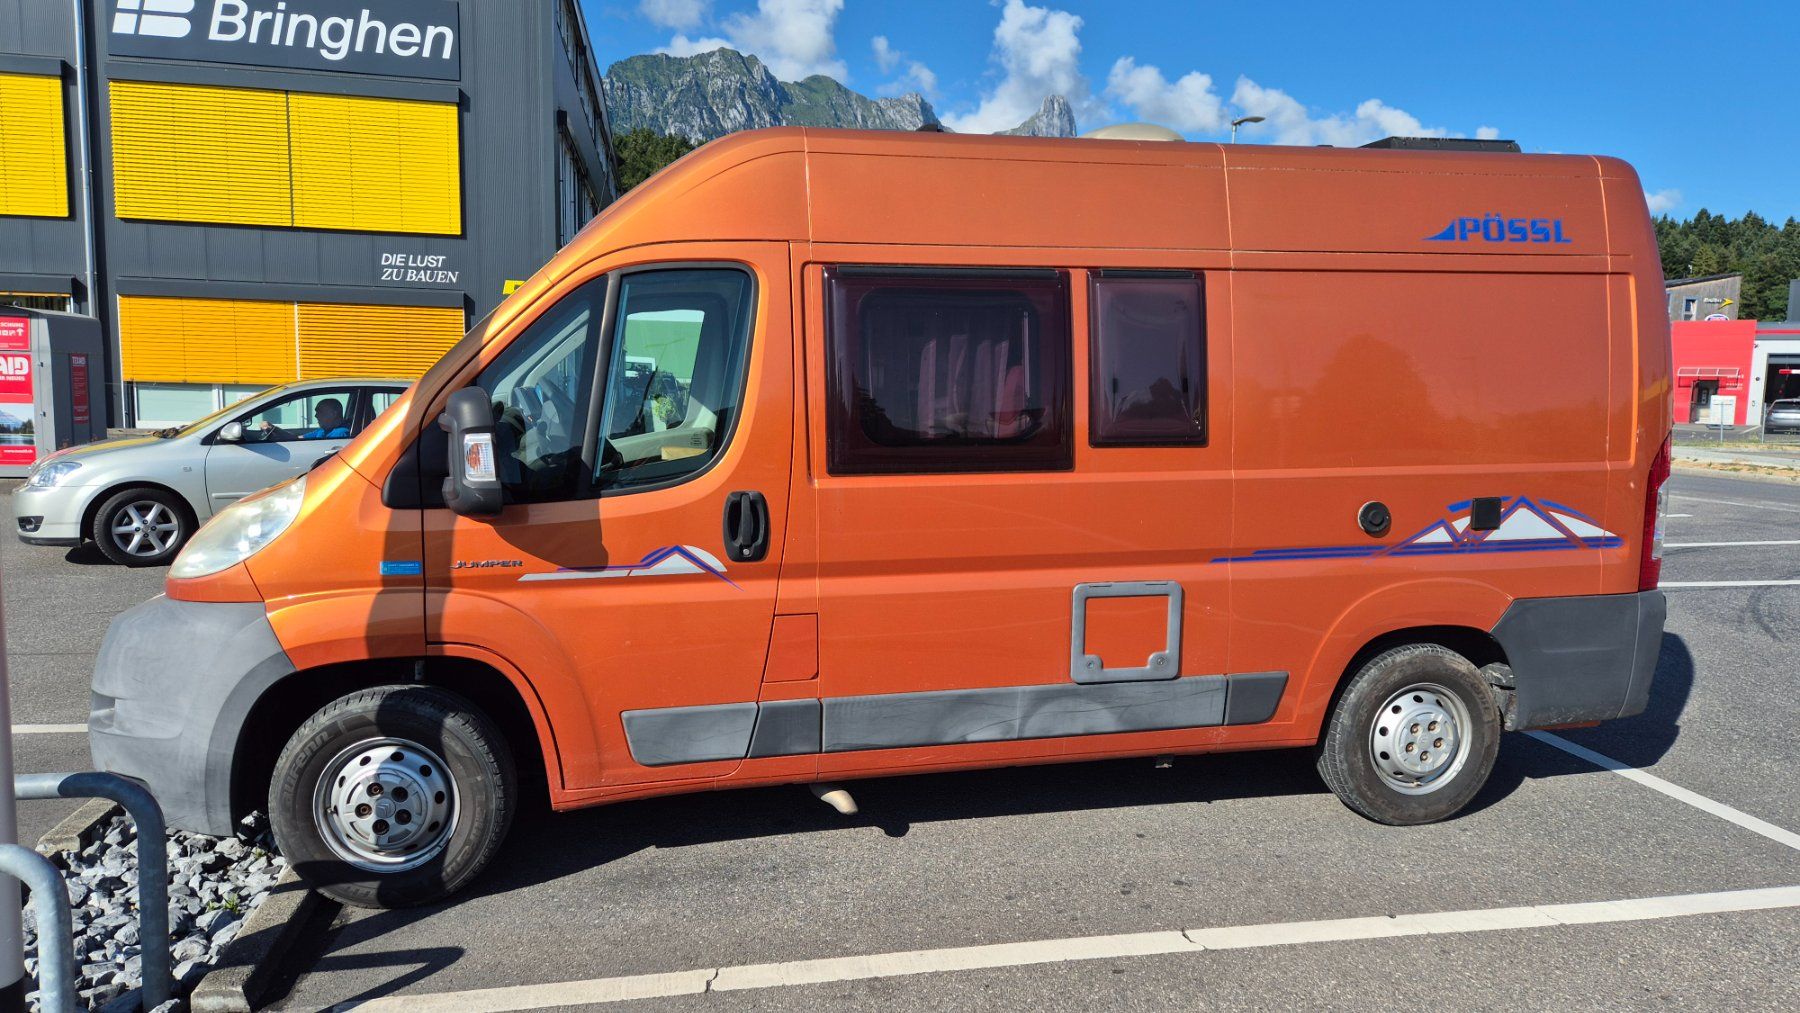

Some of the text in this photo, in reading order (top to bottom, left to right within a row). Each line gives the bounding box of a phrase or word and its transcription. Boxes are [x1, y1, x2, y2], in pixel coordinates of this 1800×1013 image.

[208, 0, 455, 61] Bringhen
[1458, 212, 1573, 244] PÖSSL
[381, 253, 446, 267] DIE LUST
[381, 268, 459, 283] ZU BAUEN
[450, 560, 523, 569] JUMPER
